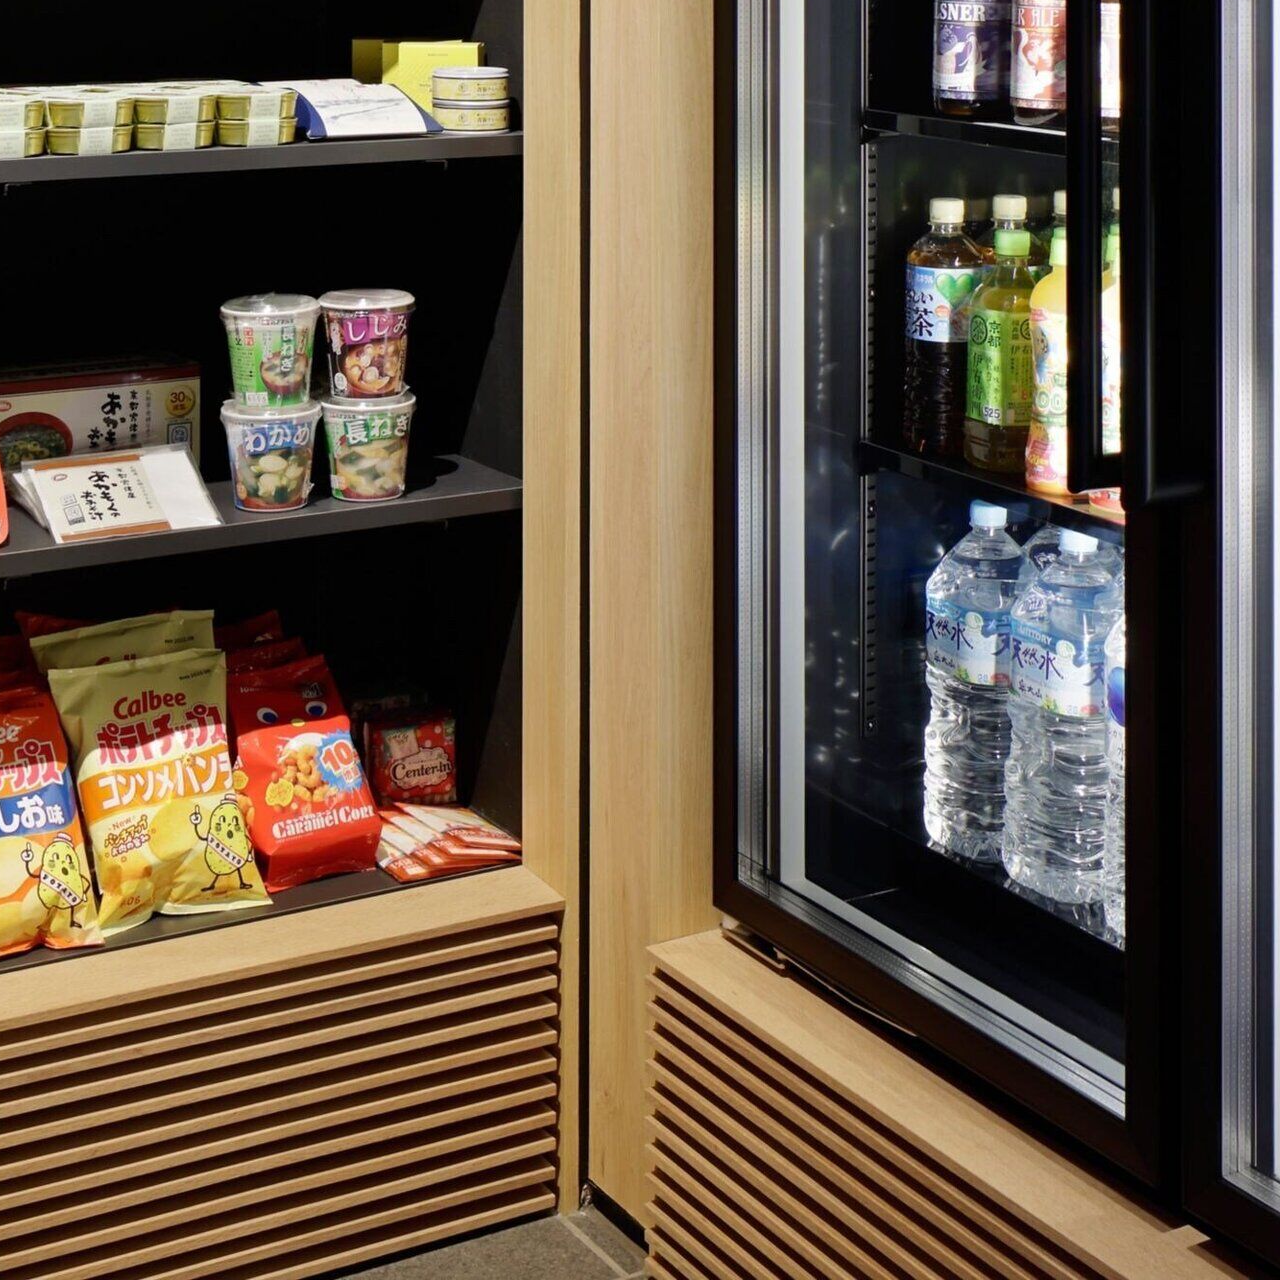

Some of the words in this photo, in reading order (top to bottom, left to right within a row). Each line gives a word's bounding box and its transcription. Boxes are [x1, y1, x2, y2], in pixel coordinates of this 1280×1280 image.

[1032, 8, 1060, 28] ALE
[347, 314, 408, 342] しじみ
[988, 320, 1001, 348] 京都
[345, 412, 408, 443] 長ねぎ
[983, 406, 1000, 419] 525
[245, 424, 312, 453] わかめ
[1011, 636, 1064, 681] 天然水
[113, 690, 187, 720] Calbee
[97, 704, 227, 766] ポテトチップス
[98, 751, 233, 810] コンソメパンチ
[272, 808, 338, 840] Caramel
[208, 837, 243, 865] POTATO
[42, 872, 80, 905] POTATO
